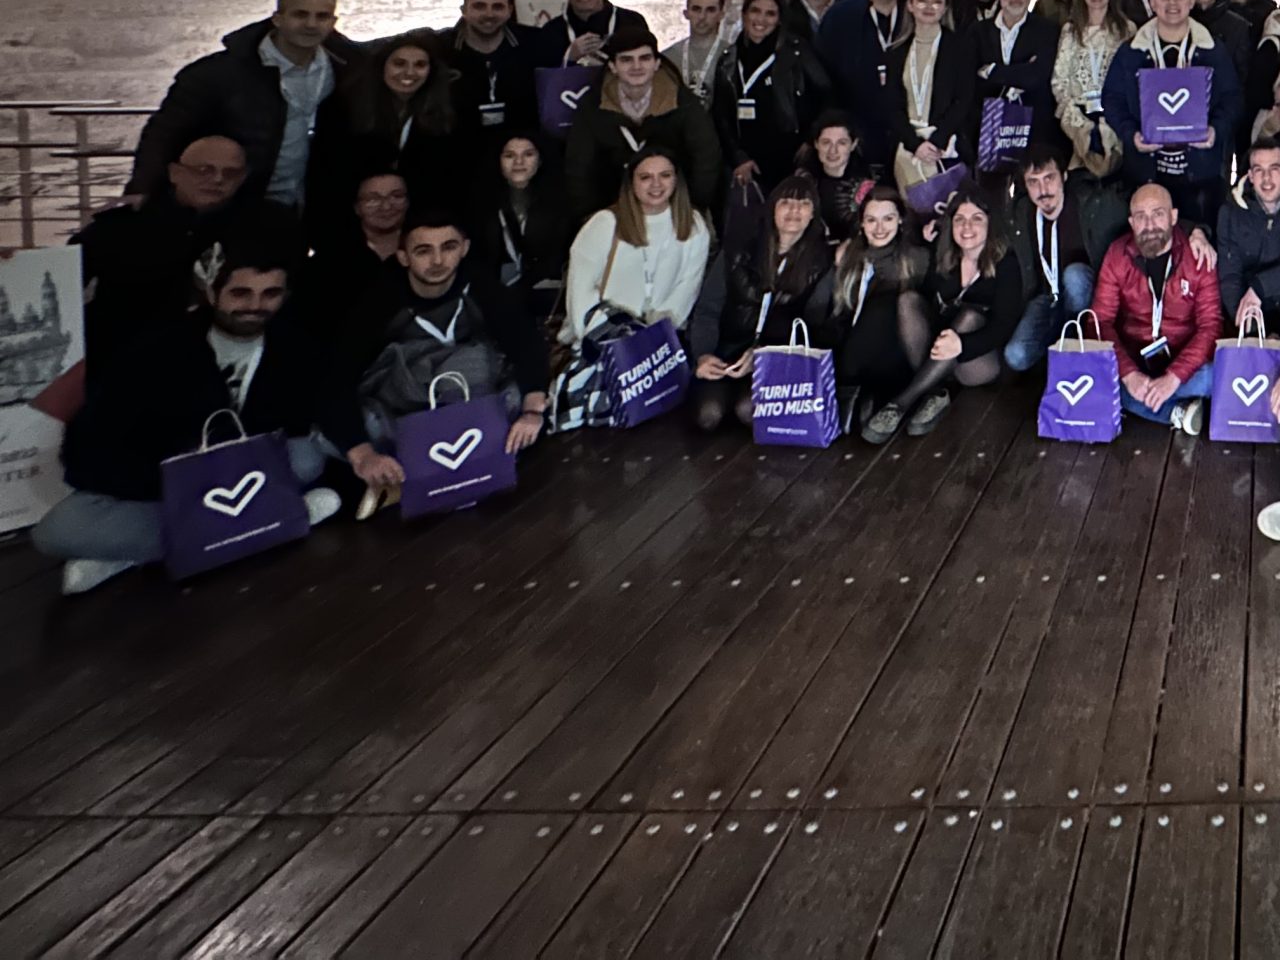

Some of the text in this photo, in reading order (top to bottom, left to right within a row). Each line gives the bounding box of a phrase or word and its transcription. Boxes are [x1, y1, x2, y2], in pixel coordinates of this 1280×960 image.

[618, 342, 671, 387] TURN LIFE
[620, 375, 653, 404] INTO
[653, 349, 687, 382] MUSIC
[753, 397, 825, 418] INTO MUSIC
[758, 382, 814, 400] TURN LIFE
